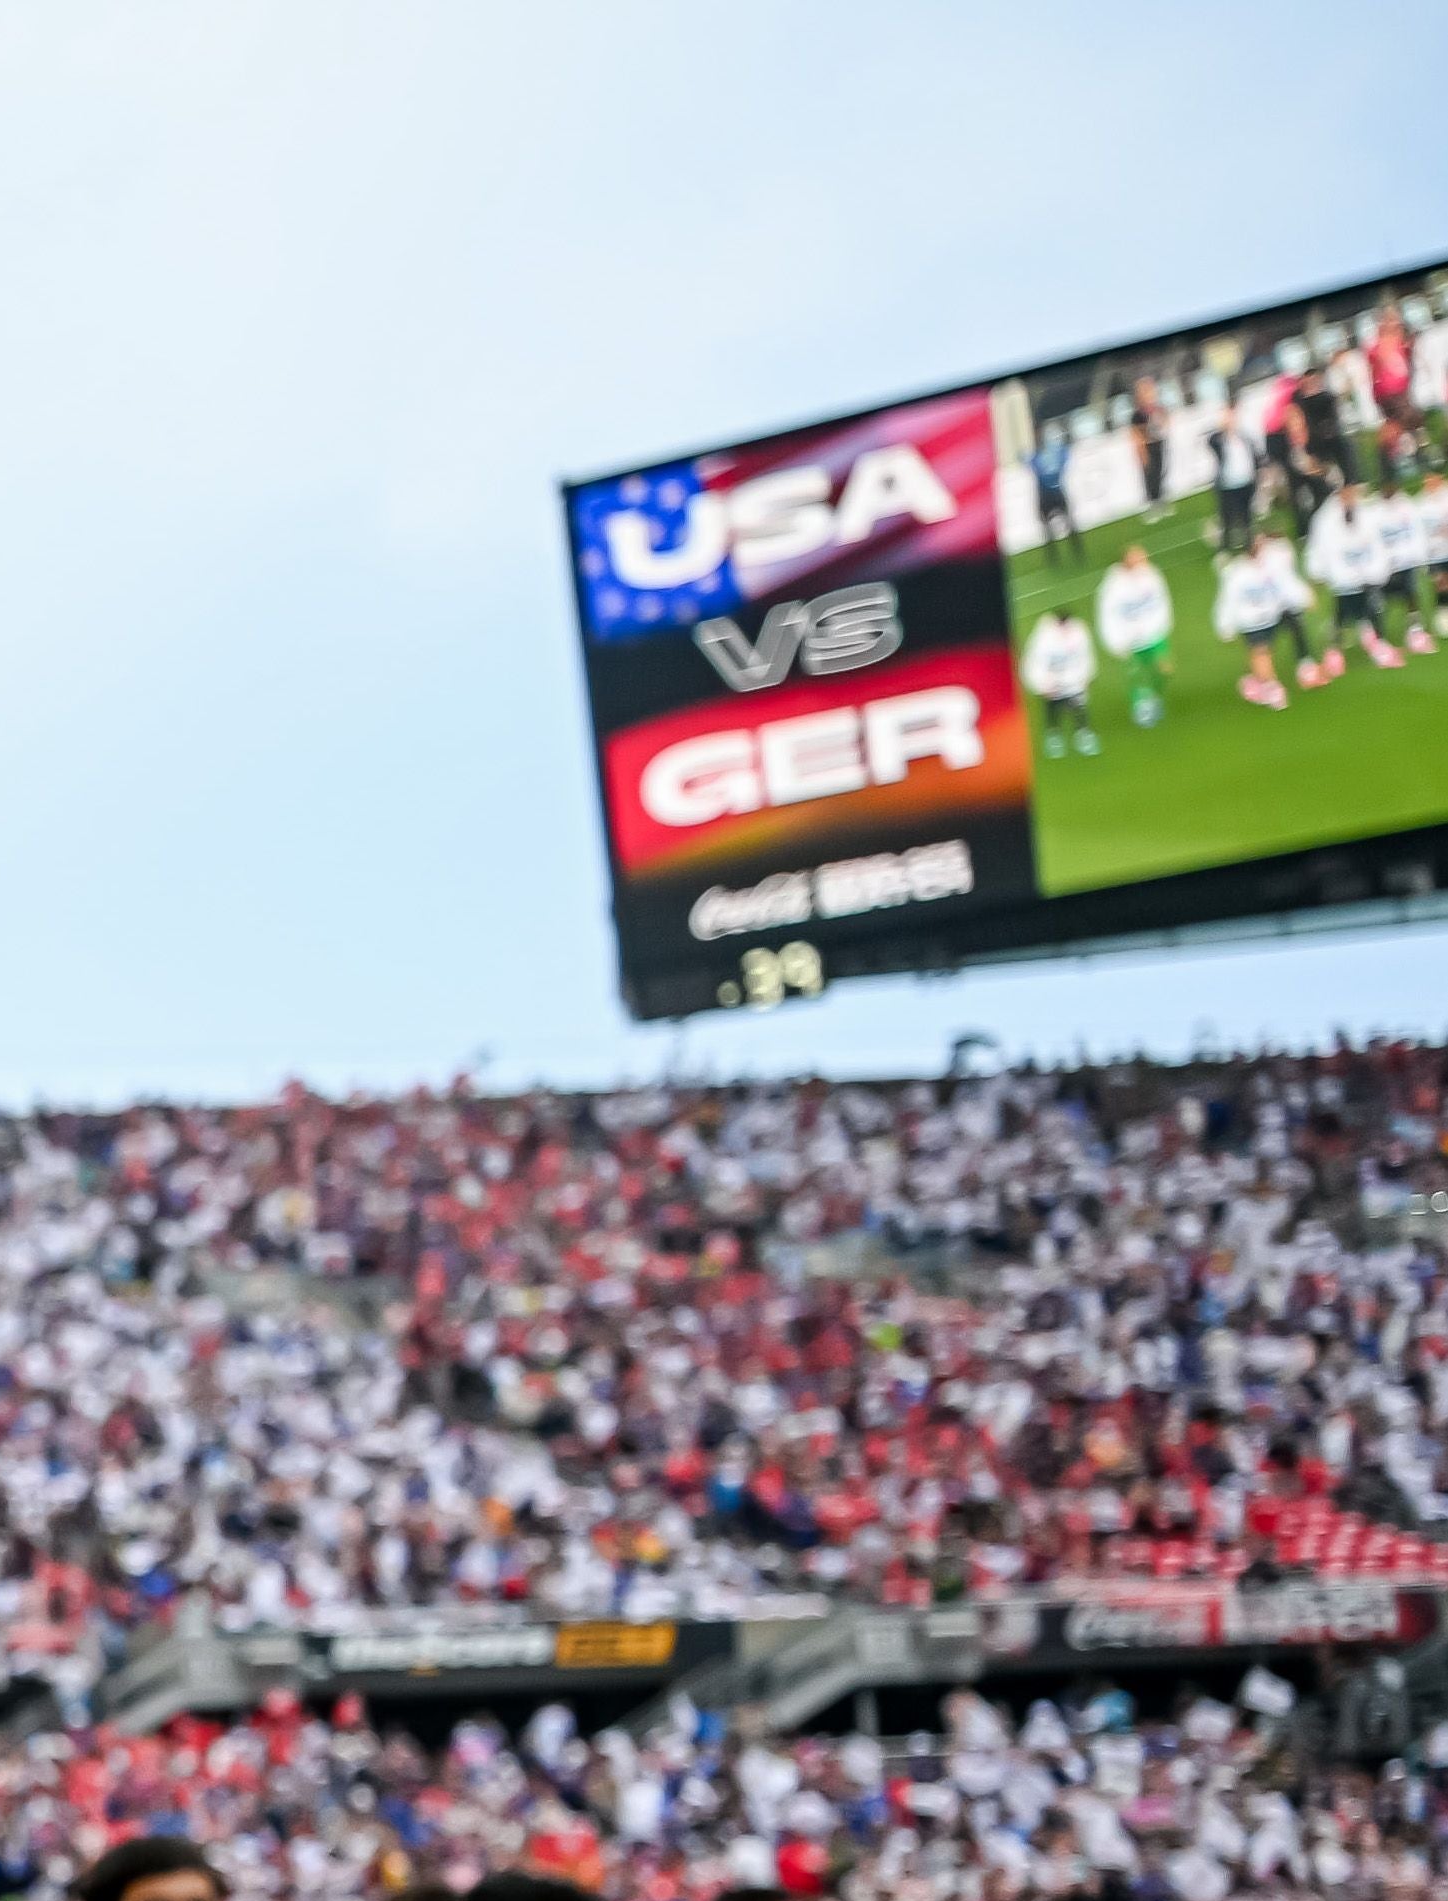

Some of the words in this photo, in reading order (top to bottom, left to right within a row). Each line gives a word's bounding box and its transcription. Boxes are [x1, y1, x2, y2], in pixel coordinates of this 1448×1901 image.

[605, 444, 959, 591] USA
[693, 582, 903, 693] VS
[639, 687, 985, 827] GER
